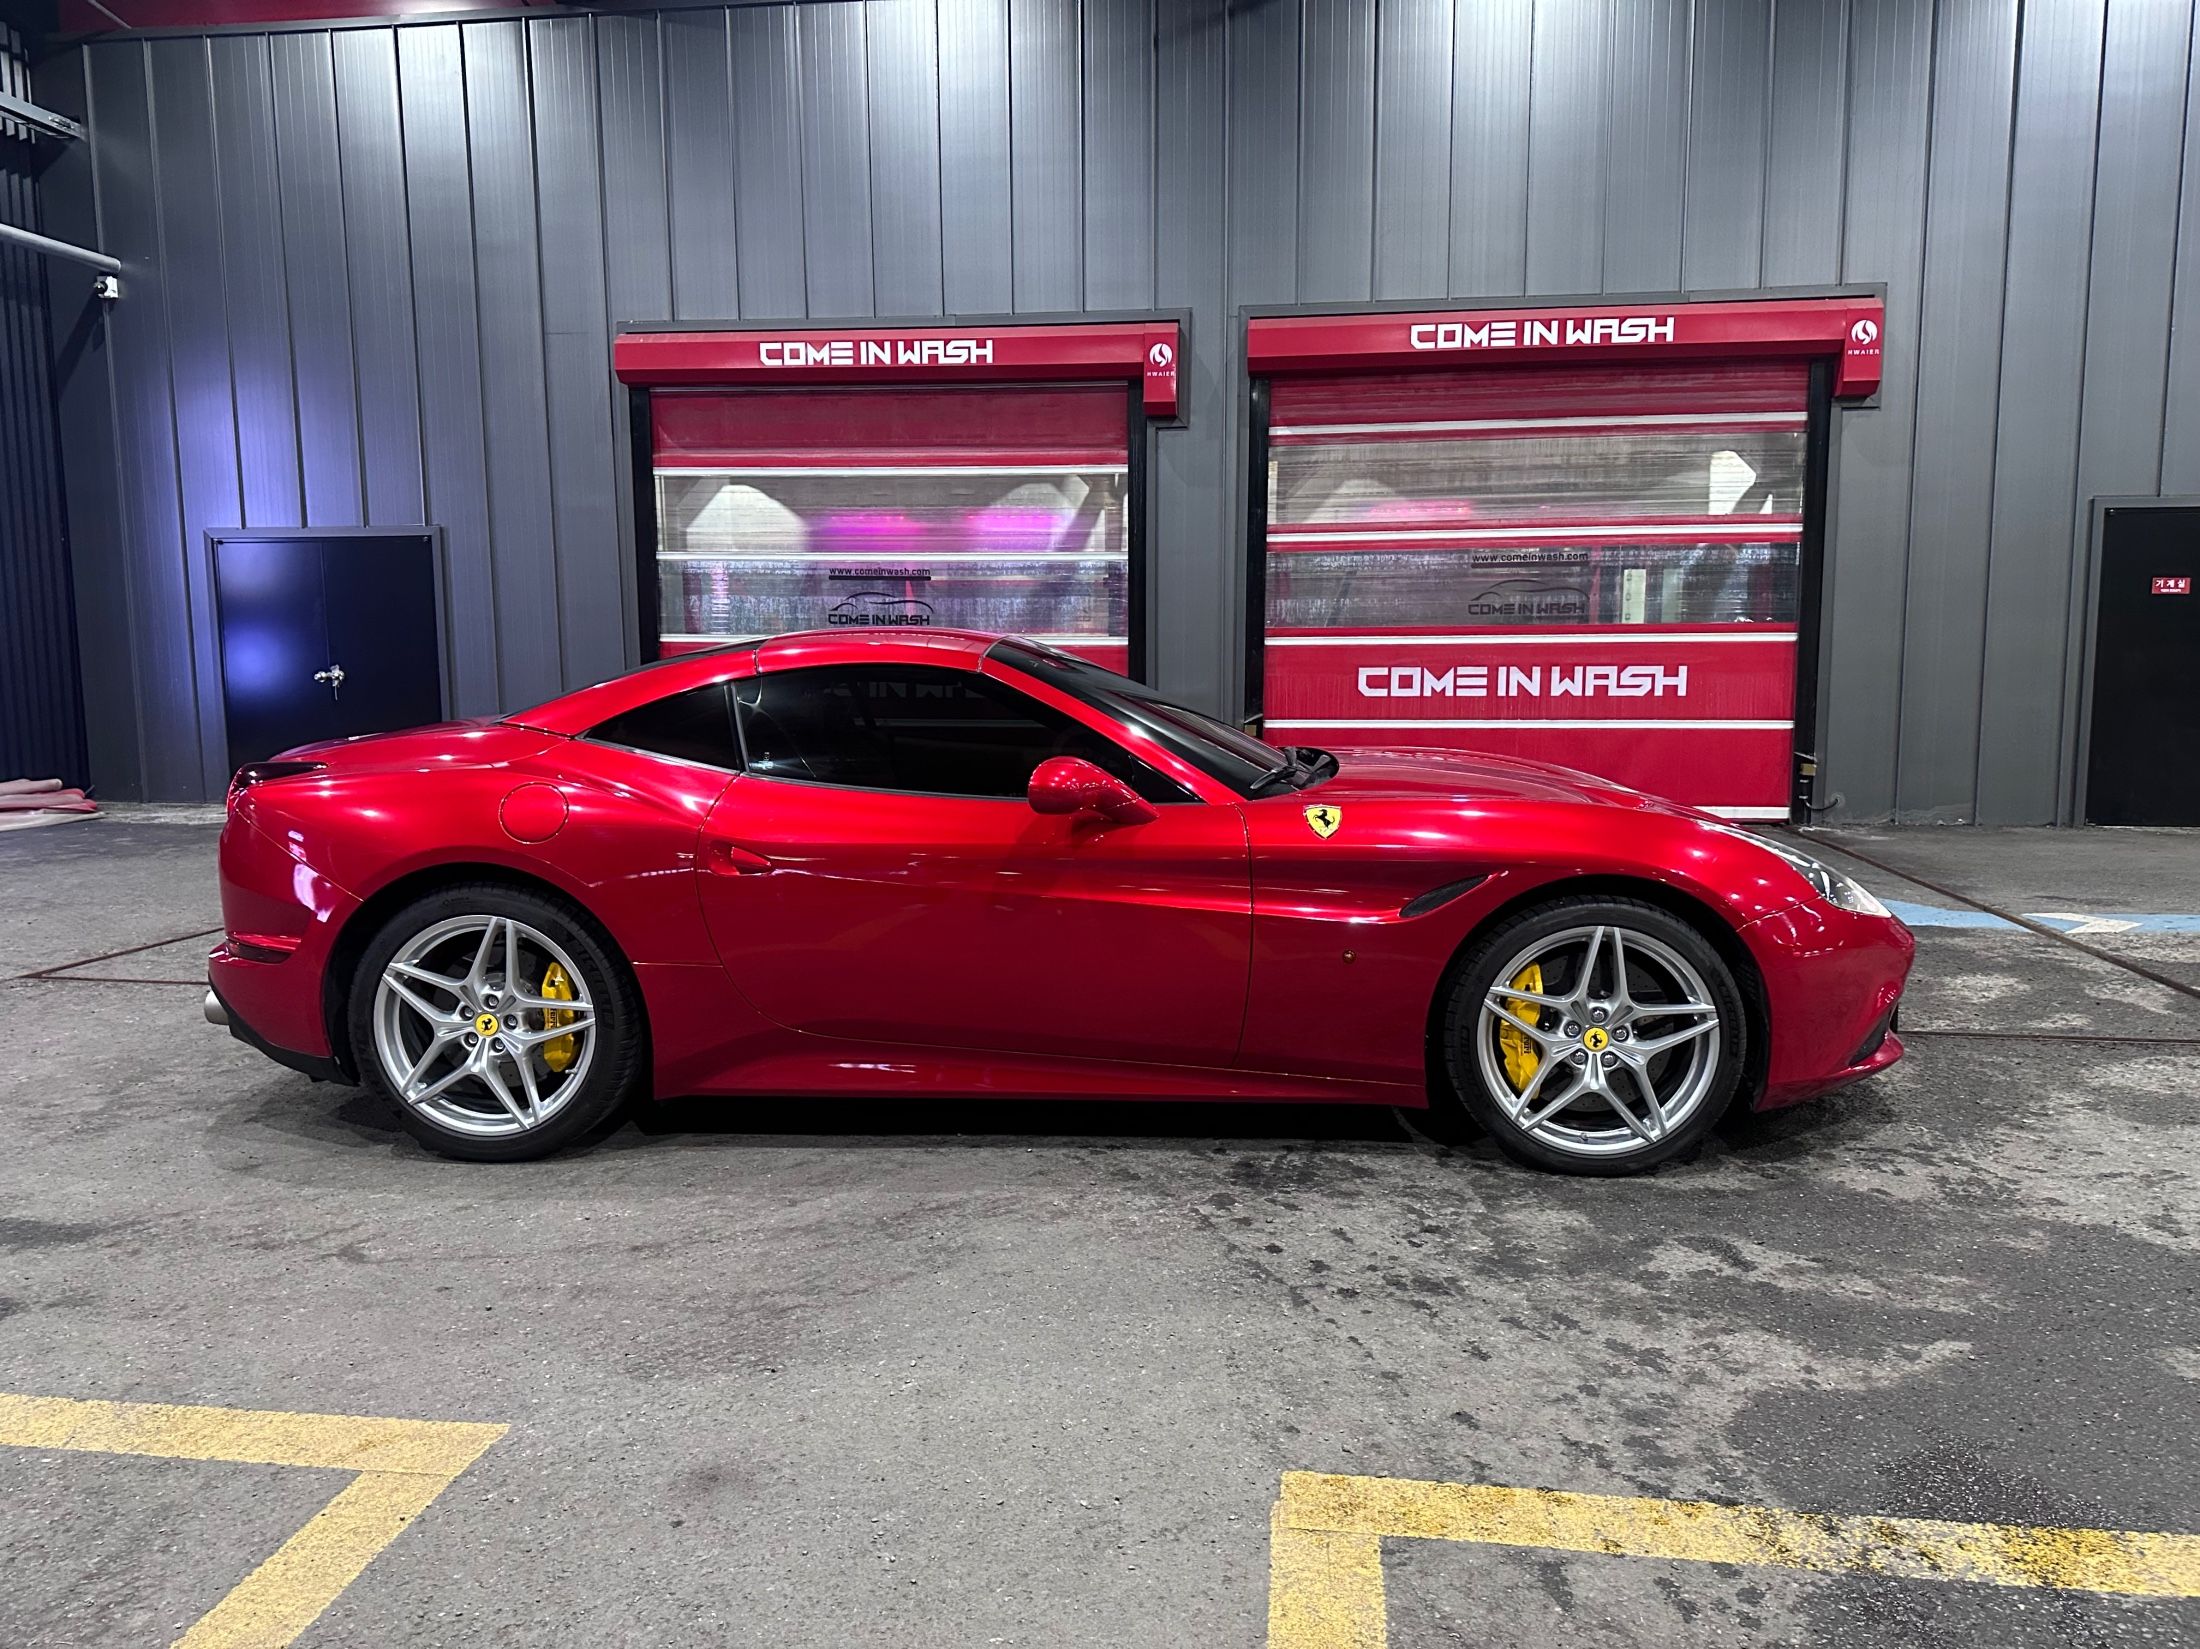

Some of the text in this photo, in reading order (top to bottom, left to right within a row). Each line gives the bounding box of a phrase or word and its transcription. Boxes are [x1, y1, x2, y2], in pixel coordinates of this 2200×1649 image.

[1410, 317, 1675, 349] COME IN WASH
[759, 339, 994, 366] COME IN WASH
[1472, 552, 1589, 562] www.comeinwash.com
[829, 567, 931, 576] www.comeinwash.com
[1468, 603, 1585, 615] COME IN WASH
[828, 614, 930, 625] COME IN WASH
[1357, 665, 1688, 697] COME IN WASH
